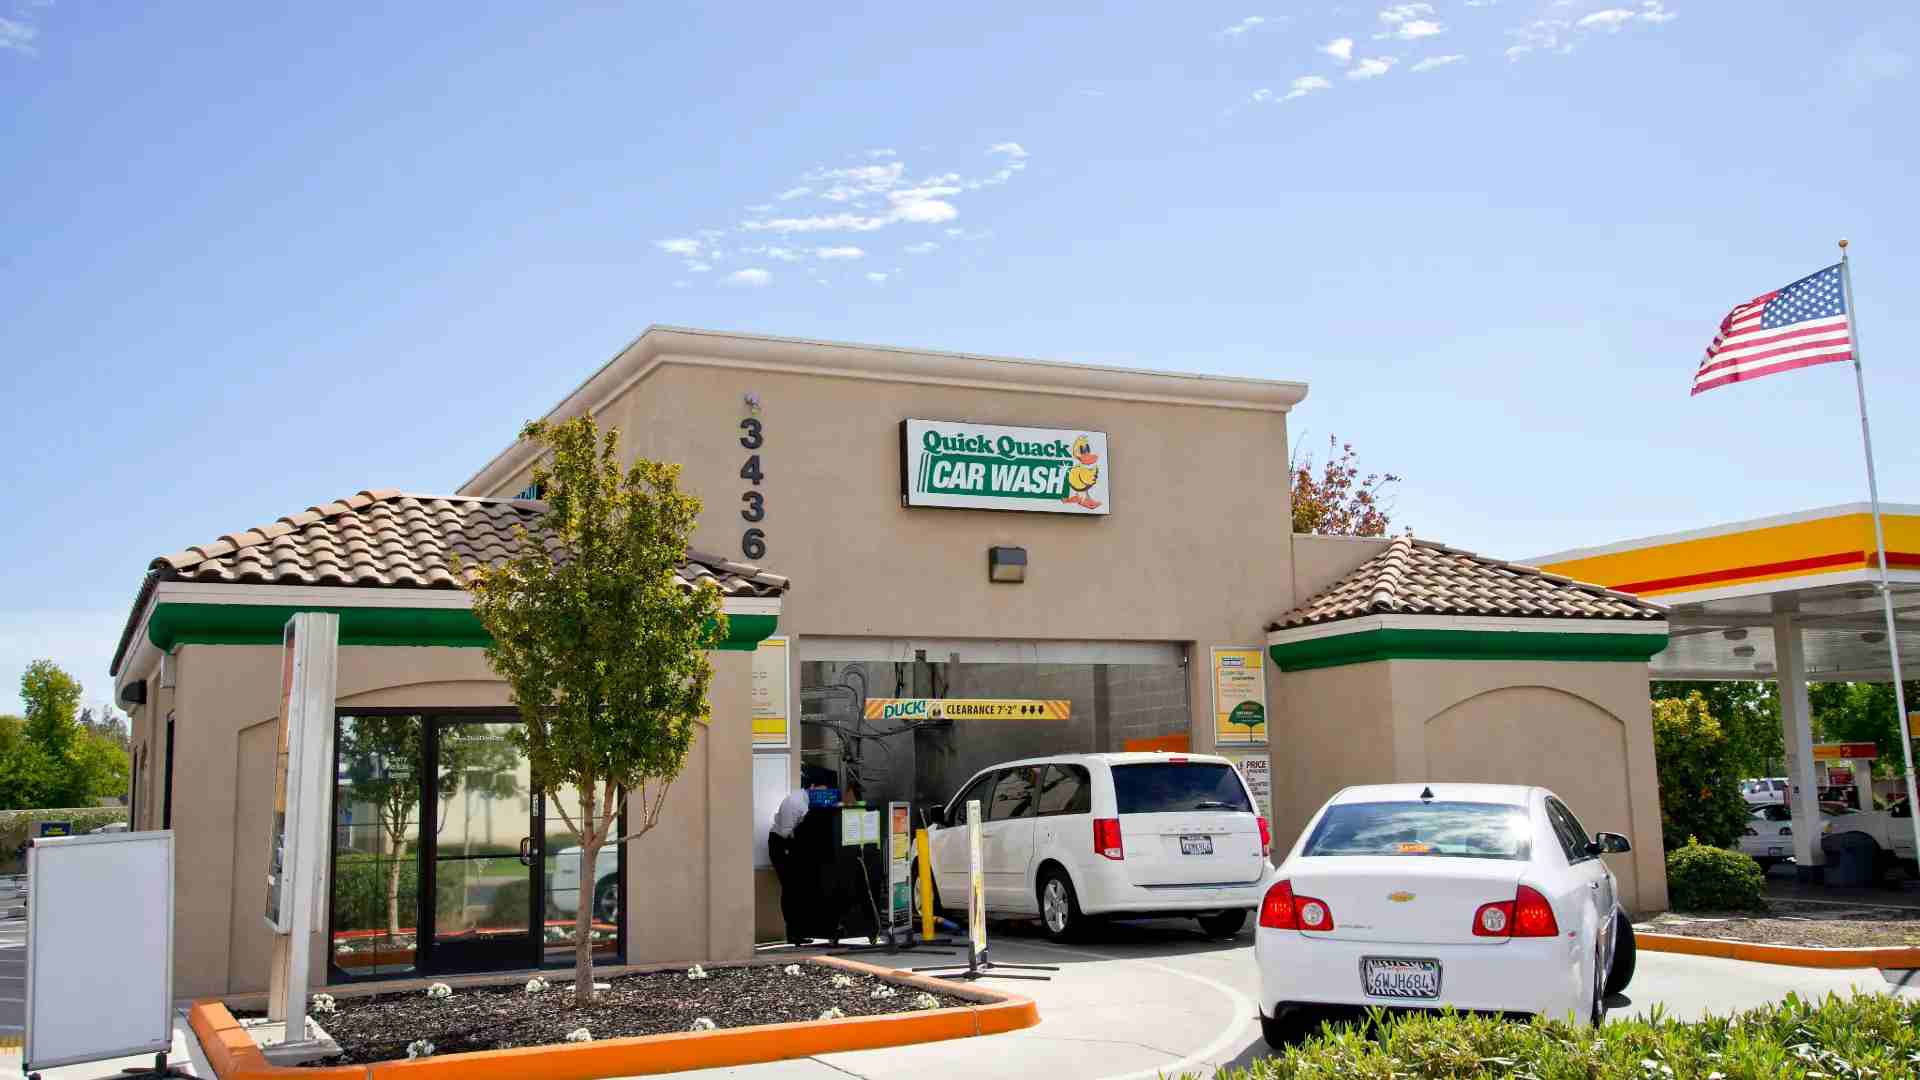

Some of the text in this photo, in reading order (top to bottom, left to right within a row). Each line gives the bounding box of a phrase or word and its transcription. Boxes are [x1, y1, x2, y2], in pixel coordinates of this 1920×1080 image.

[923, 430, 1072, 459] Quick Quack
[740, 417, 766, 560] 3436
[932, 460, 1065, 495] CAR WASH
[884, 700, 927, 718] DUCK!
[946, 704, 994, 714] CLEARANCE
[1246, 760, 1266, 769] PRICE
